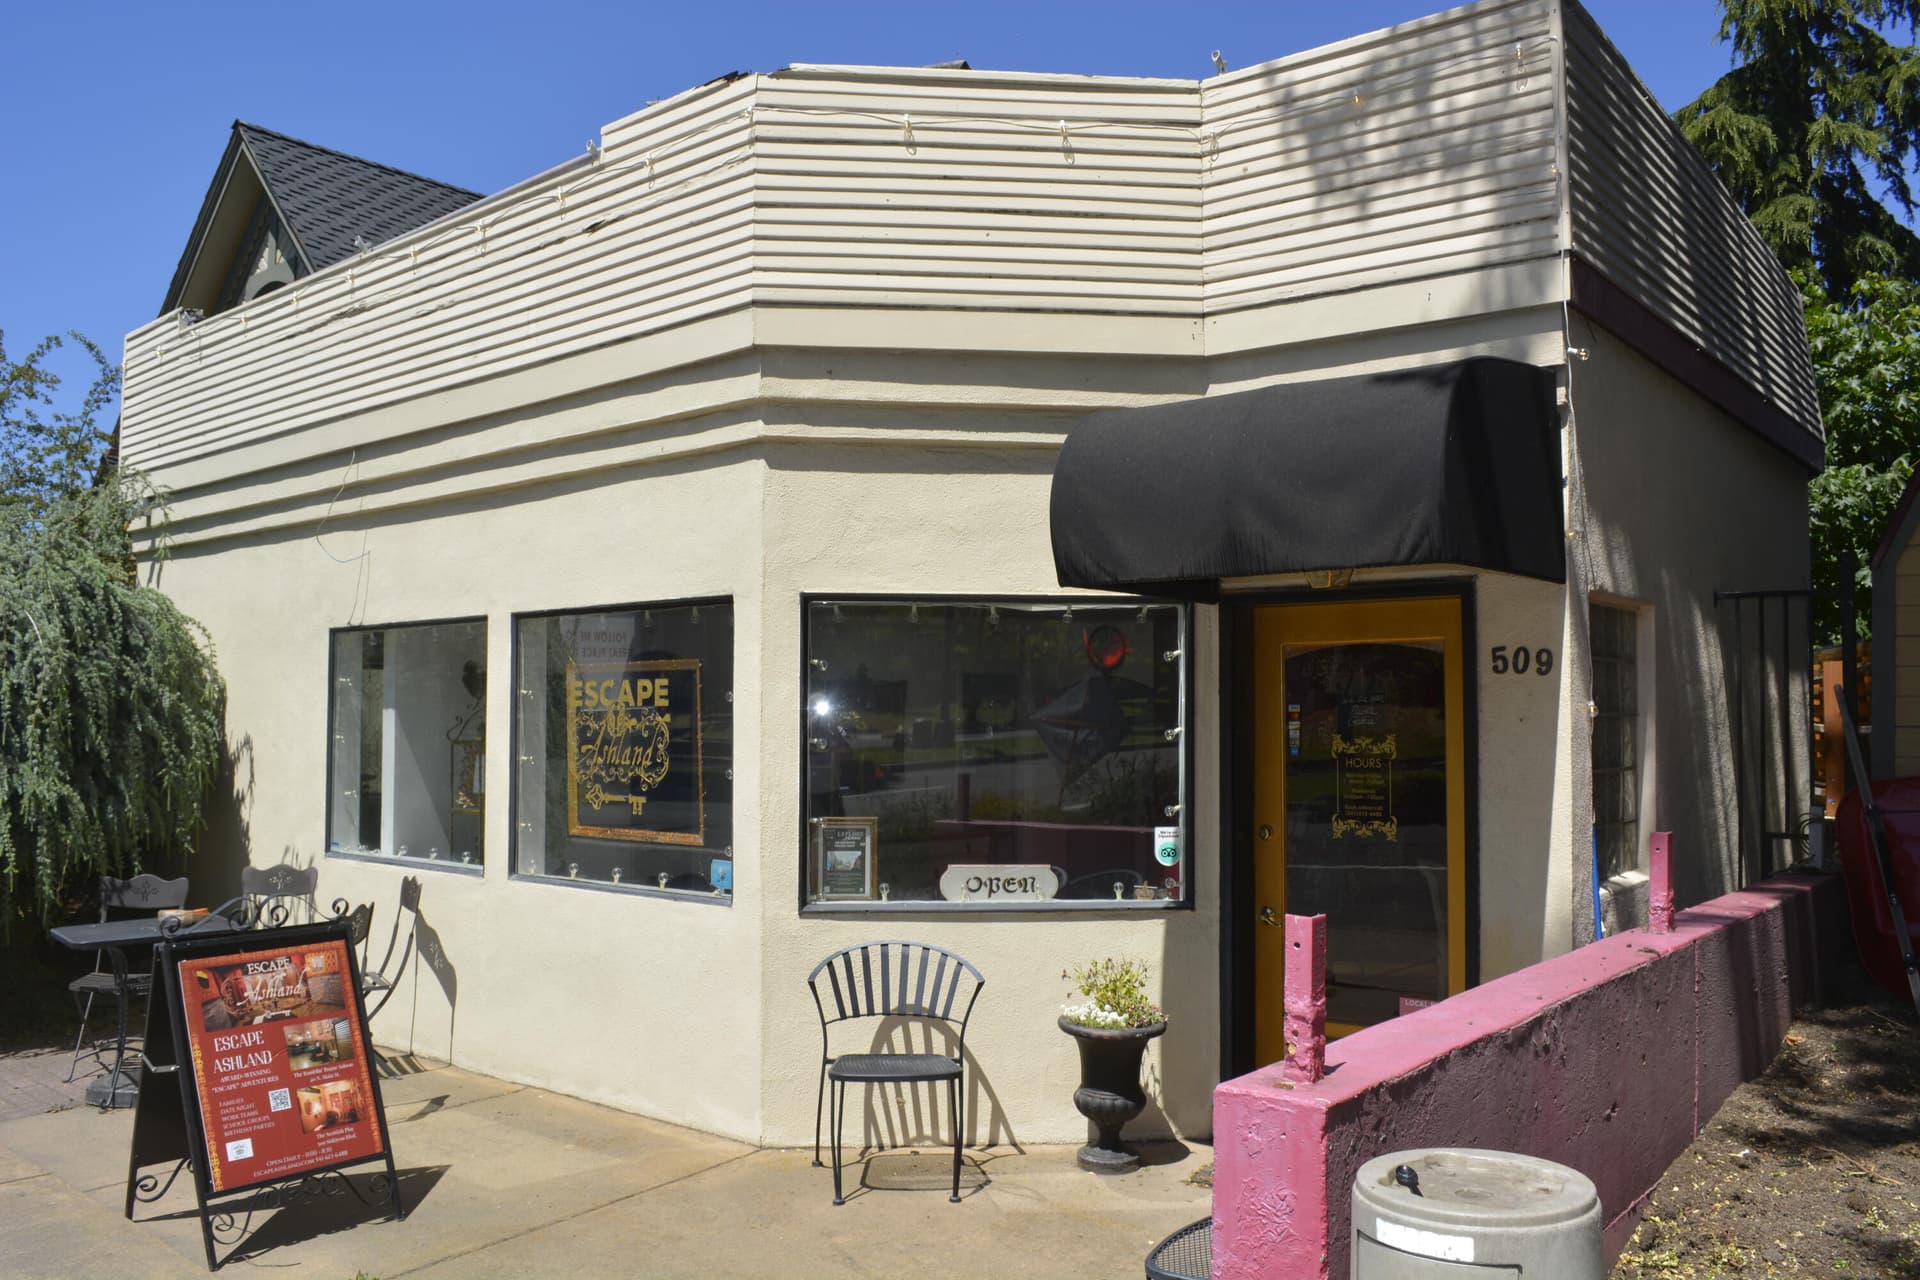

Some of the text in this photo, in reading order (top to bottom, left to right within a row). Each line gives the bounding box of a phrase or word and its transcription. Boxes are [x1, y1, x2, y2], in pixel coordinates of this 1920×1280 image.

[1491, 645, 1553, 676] 509
[573, 678, 670, 707] ESCAPE
[578, 718, 665, 779] Ashland
[1345, 757, 1382, 769] HOURS
[246, 958, 290, 975] ESCAPE
[237, 968, 309, 1005] Ashland
[213, 1030, 264, 1052] ESCAPE
[213, 1050, 272, 1074] ASHLAND
